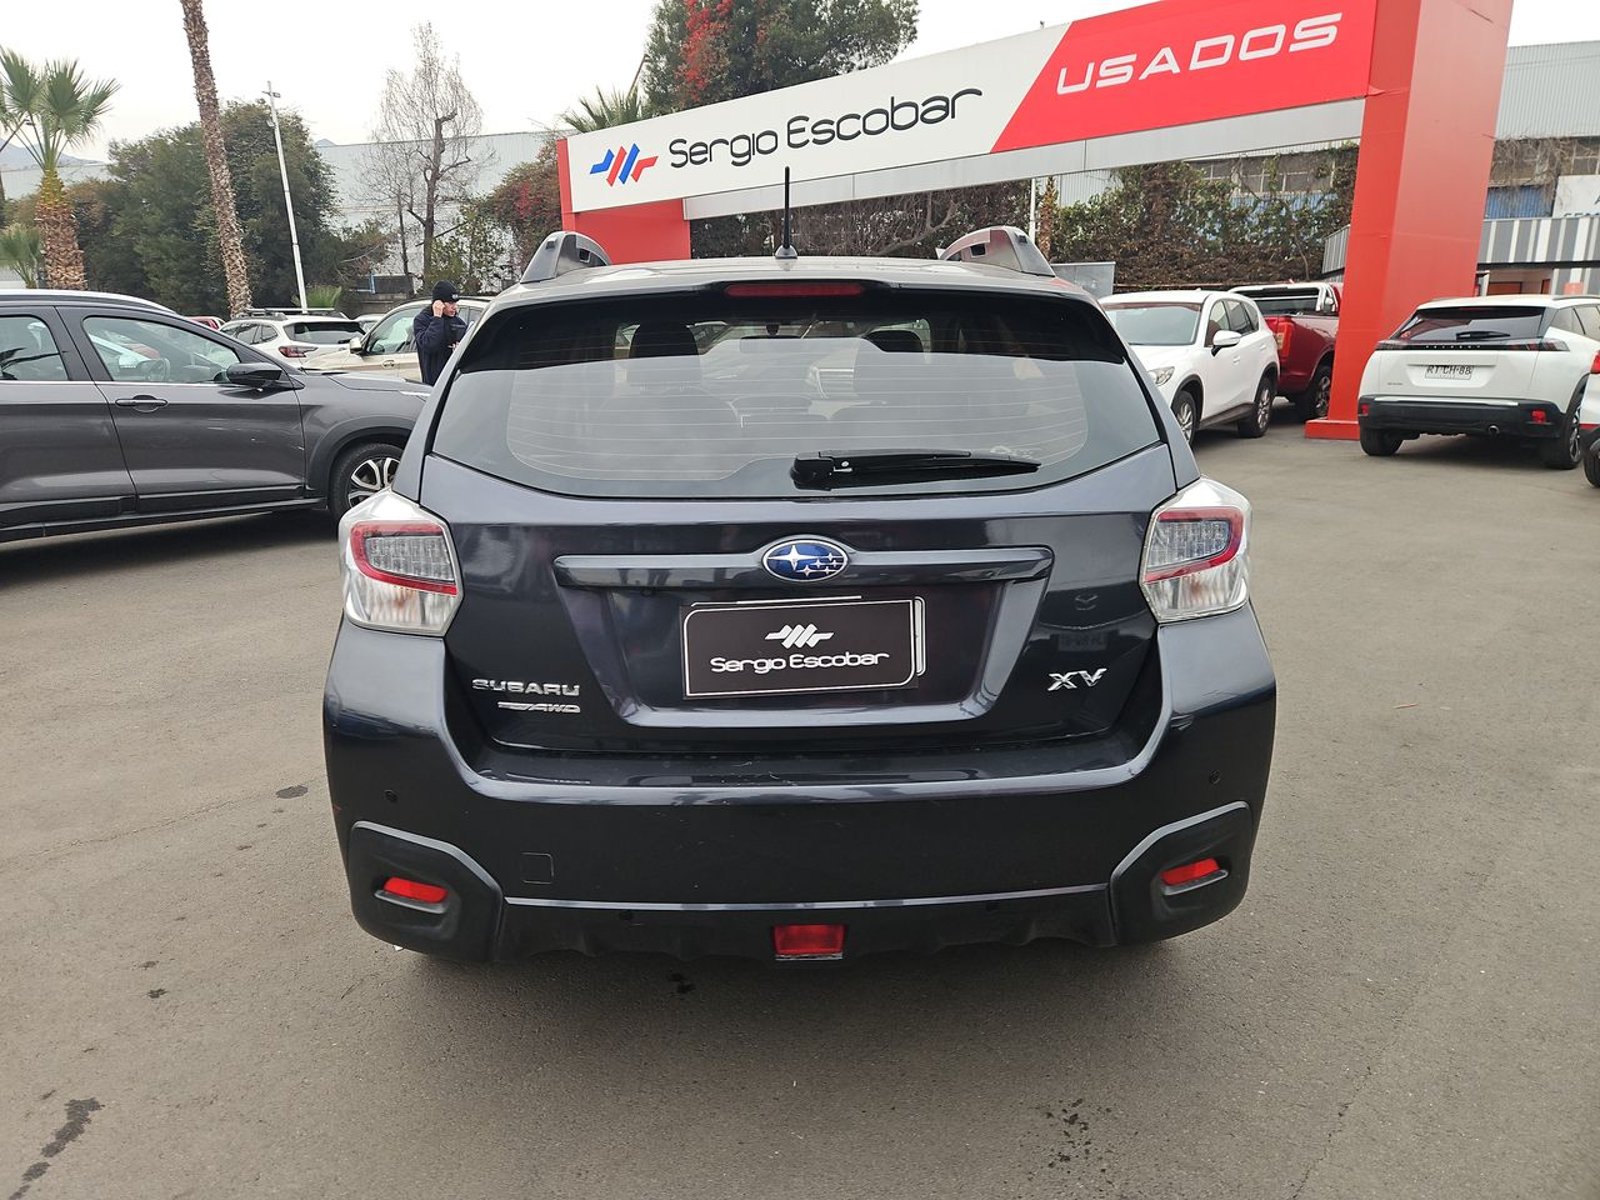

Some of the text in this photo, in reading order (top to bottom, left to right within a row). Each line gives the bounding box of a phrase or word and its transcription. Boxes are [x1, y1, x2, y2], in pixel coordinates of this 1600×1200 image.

[1056, 12, 1343, 95] USADOS
[669, 88, 982, 168] Sergio Escobar
[710, 651, 890, 674] Sergio Escobar
[472, 679, 580, 696] SUBARU
[1048, 668, 1107, 691] XV
